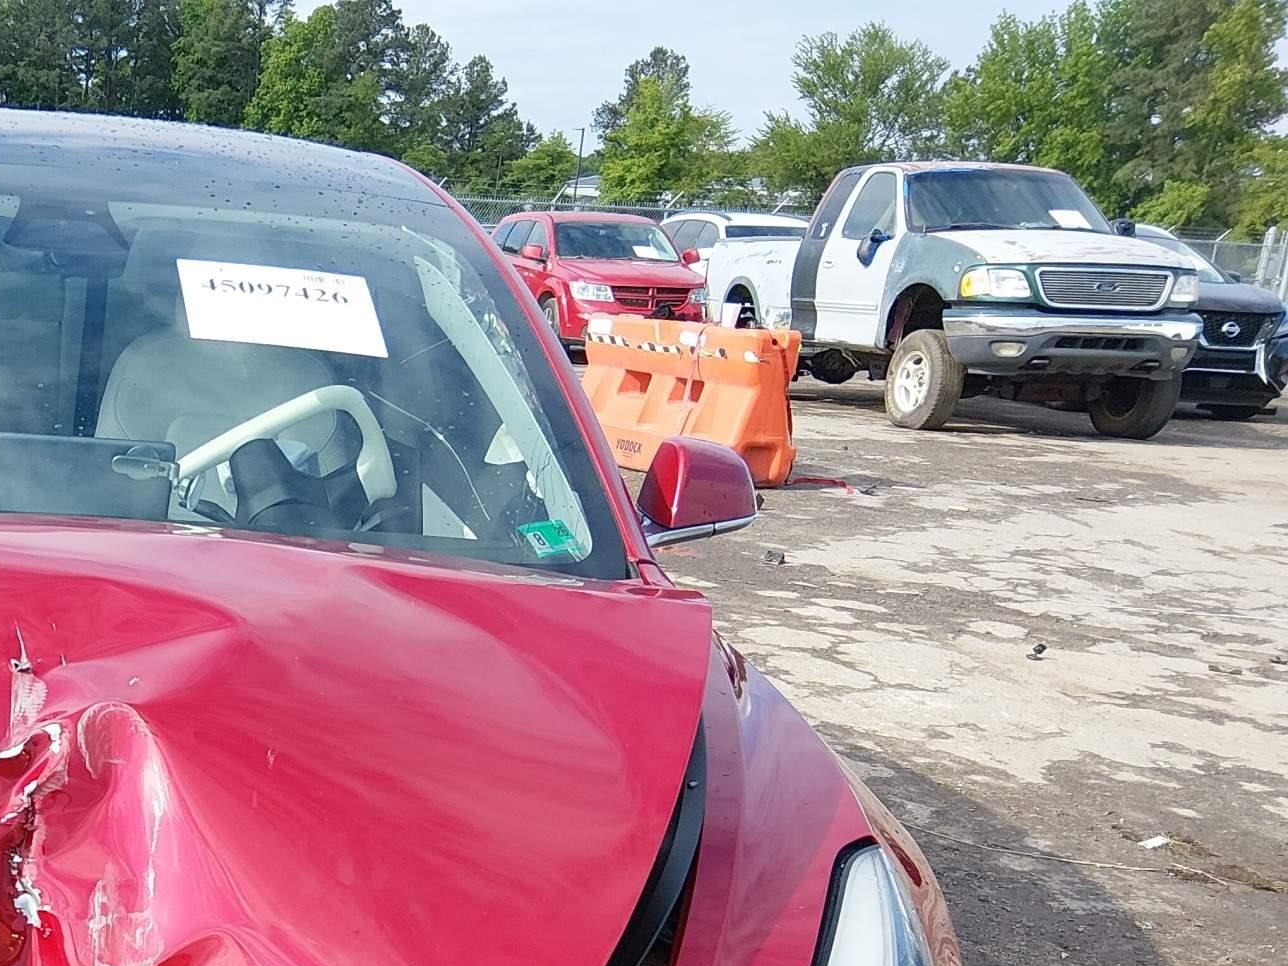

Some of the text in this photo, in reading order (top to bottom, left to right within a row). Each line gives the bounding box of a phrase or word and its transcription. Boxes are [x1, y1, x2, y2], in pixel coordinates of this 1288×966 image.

[201, 277, 349, 304] 45097426
[616, 438, 643, 454] YODOCK
[532, 532, 547, 546] 8
